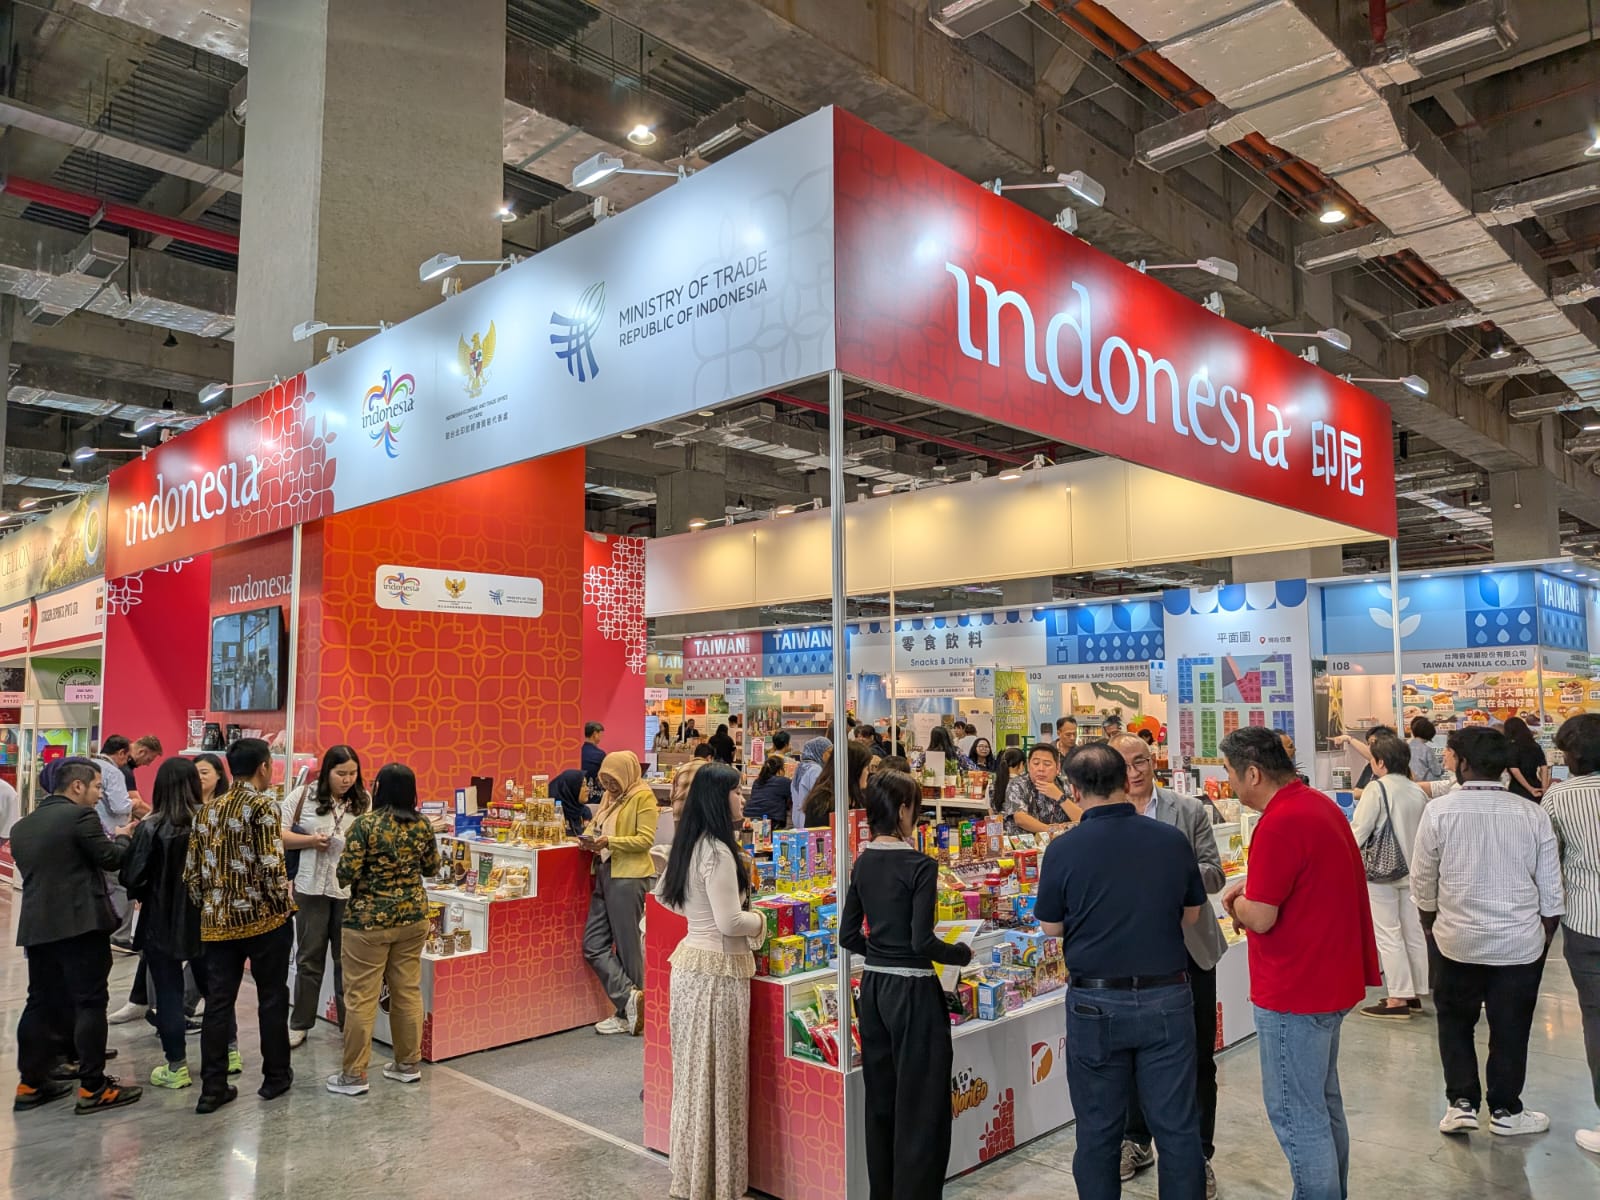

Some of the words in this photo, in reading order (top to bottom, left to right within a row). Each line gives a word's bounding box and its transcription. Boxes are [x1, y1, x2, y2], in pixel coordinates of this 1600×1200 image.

[619, 285, 684, 328] MINISTRY
[688, 274, 709, 299] OF
[713, 250, 768, 288] TRADE
[619, 314, 674, 347] REPUBLIC
[677, 306, 693, 325] OF
[696, 278, 768, 318] INDONESIA
[945, 261, 1291, 470] indonesia
[1311, 420, 1365, 497] 印尼
[361, 395, 415, 430] indonesia
[125, 454, 262, 547] indonesia
[229, 573, 294, 605] indonesia
[383, 579, 420, 592] indonesia
[1543, 578, 1578, 614] TAIWAN
[694, 637, 745, 656] TAIWAN
[773, 630, 832, 650] TAIWAN
[902, 631, 982, 652] 零食飲料
[1216, 631, 1251, 643] 平面圖
[910, 658, 938, 667] Snacks
[948, 657, 974, 665] Drinks
[1332, 662, 1350, 671] 108
[1422, 661, 1454, 669] TAIWAN
[1456, 660, 1491, 668] VANILLA
[1029, 672, 1042, 680] 103
